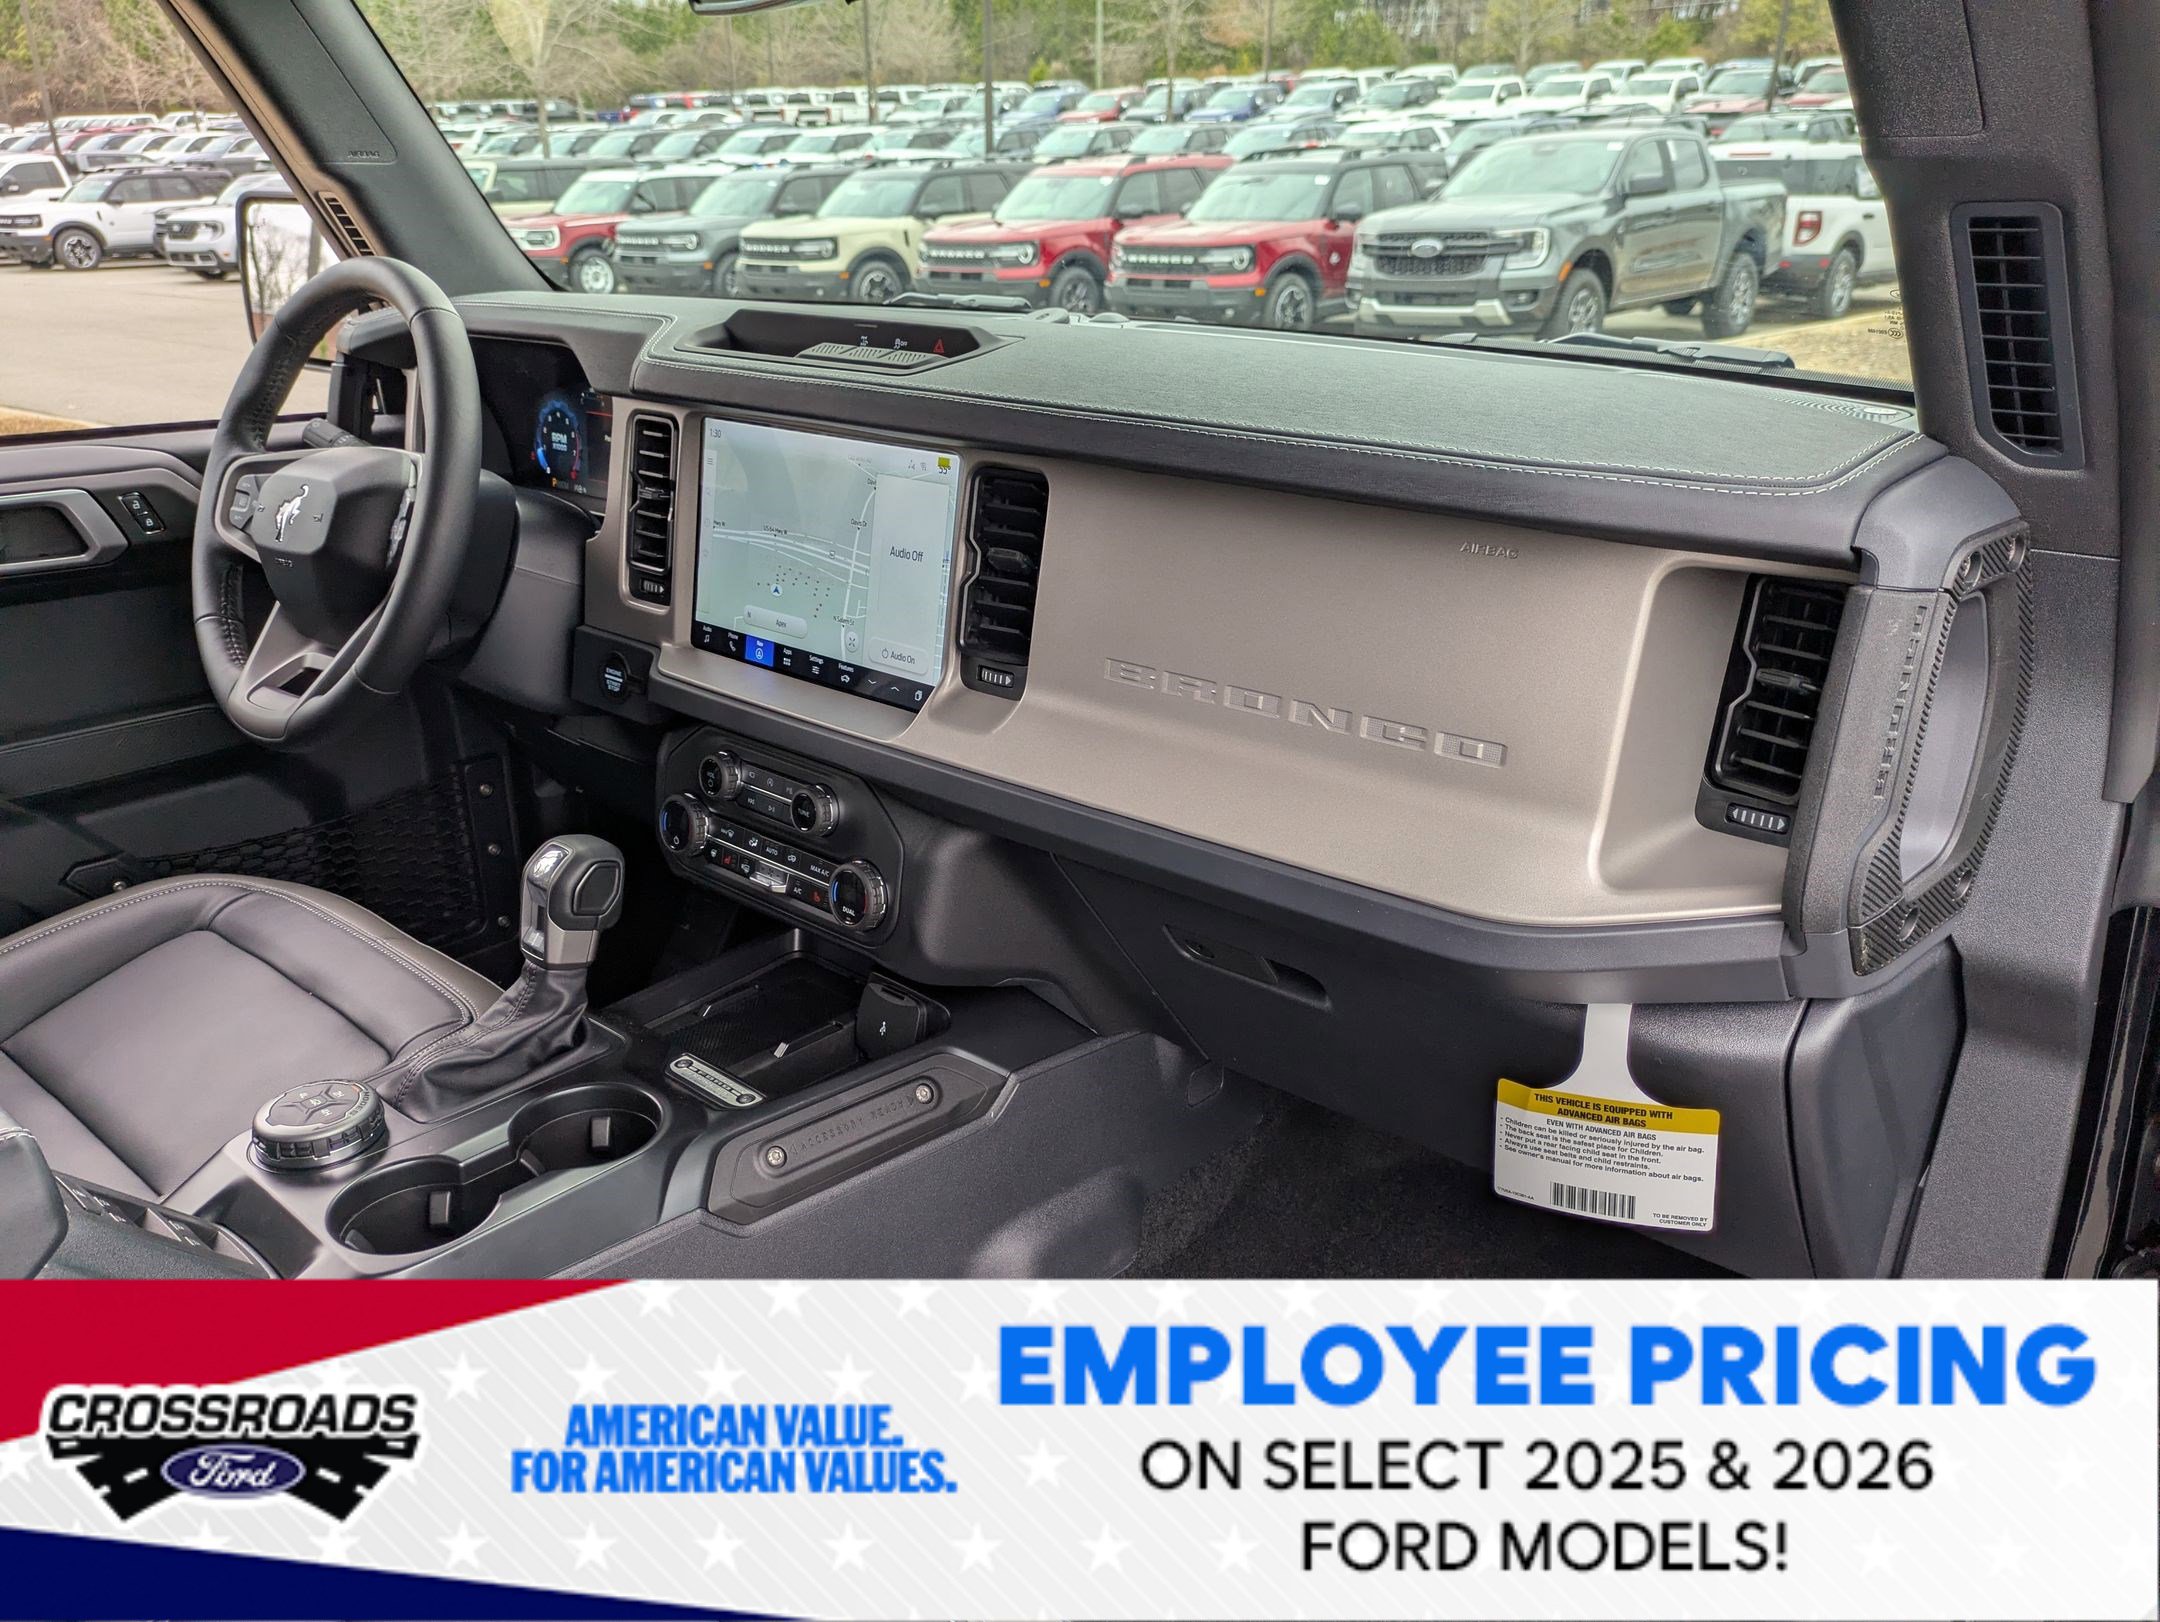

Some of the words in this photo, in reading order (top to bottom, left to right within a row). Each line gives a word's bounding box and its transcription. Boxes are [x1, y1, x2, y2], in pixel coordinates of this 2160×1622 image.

[710, 428, 722, 438] 1:30
[890, 546, 911, 560] Audio
[912, 550, 924, 562] Off
[1460, 542, 1519, 559] AIRBAG
[891, 651, 906, 662] Audio
[907, 655, 915, 664] On
[1104, 657, 1508, 769] BRONCO
[766, 847, 778, 856] AUTO
[810, 865, 820, 873] MAX
[821, 869, 830, 877] A/C
[794, 887, 802, 895] A/C
[842, 906, 855, 917] DUAL
[1535, 1093, 1553, 1103] THIS
[1556, 1097, 1590, 1109] VEHICLE
[1593, 1103, 1601, 1111] IS
[1604, 1105, 1646, 1116] EQUIPPED
[1650, 1111, 1673, 1119] WITH
[1558, 1108, 1602, 1122] ADVANCED
[1605, 1116, 1620, 1124] AIR
[1623, 1118, 1646, 1127] BAGS
[1505, 1117, 1532, 1129] Children
[1548, 1126, 1557, 1134] be
[1559, 1129, 1577, 1138] killed
[1589, 1135, 1622, 1145] seriously
[1624, 1139, 1649, 1149] injured
[1652, 1142, 1660, 1150] by
[1547, 1119, 1563, 1127] EVEN
[1566, 1121, 1583, 1130] WITH
[1585, 1125, 1621, 1136] ADVANCED
[1505, 1124, 1516, 1132] The
[1518, 1127, 1534, 1137] back
[1573, 1139, 1594, 1148] safest
[1596, 1142, 1615, 1151] place
[1630, 1147, 1663, 1157] Children.
[1505, 1131, 1523, 1140] Never
[1525, 1137, 1536, 1145] put
[1560, 1143, 1580, 1153] facing
[1583, 1147, 1600, 1156] child
[1642, 1156, 1661, 1164] front.
[1505, 1138, 1528, 1149] Always
[1544, 1148, 1558, 1156] seat
[1560, 1150, 1576, 1158] belts
[1594, 1156, 1611, 1164] child
[1613, 1160, 1650, 1170] restraints.
[1518, 1150, 1544, 1160] owner's
[1546, 1156, 1571, 1165] manual
[1605, 1166, 1646, 1177] information
